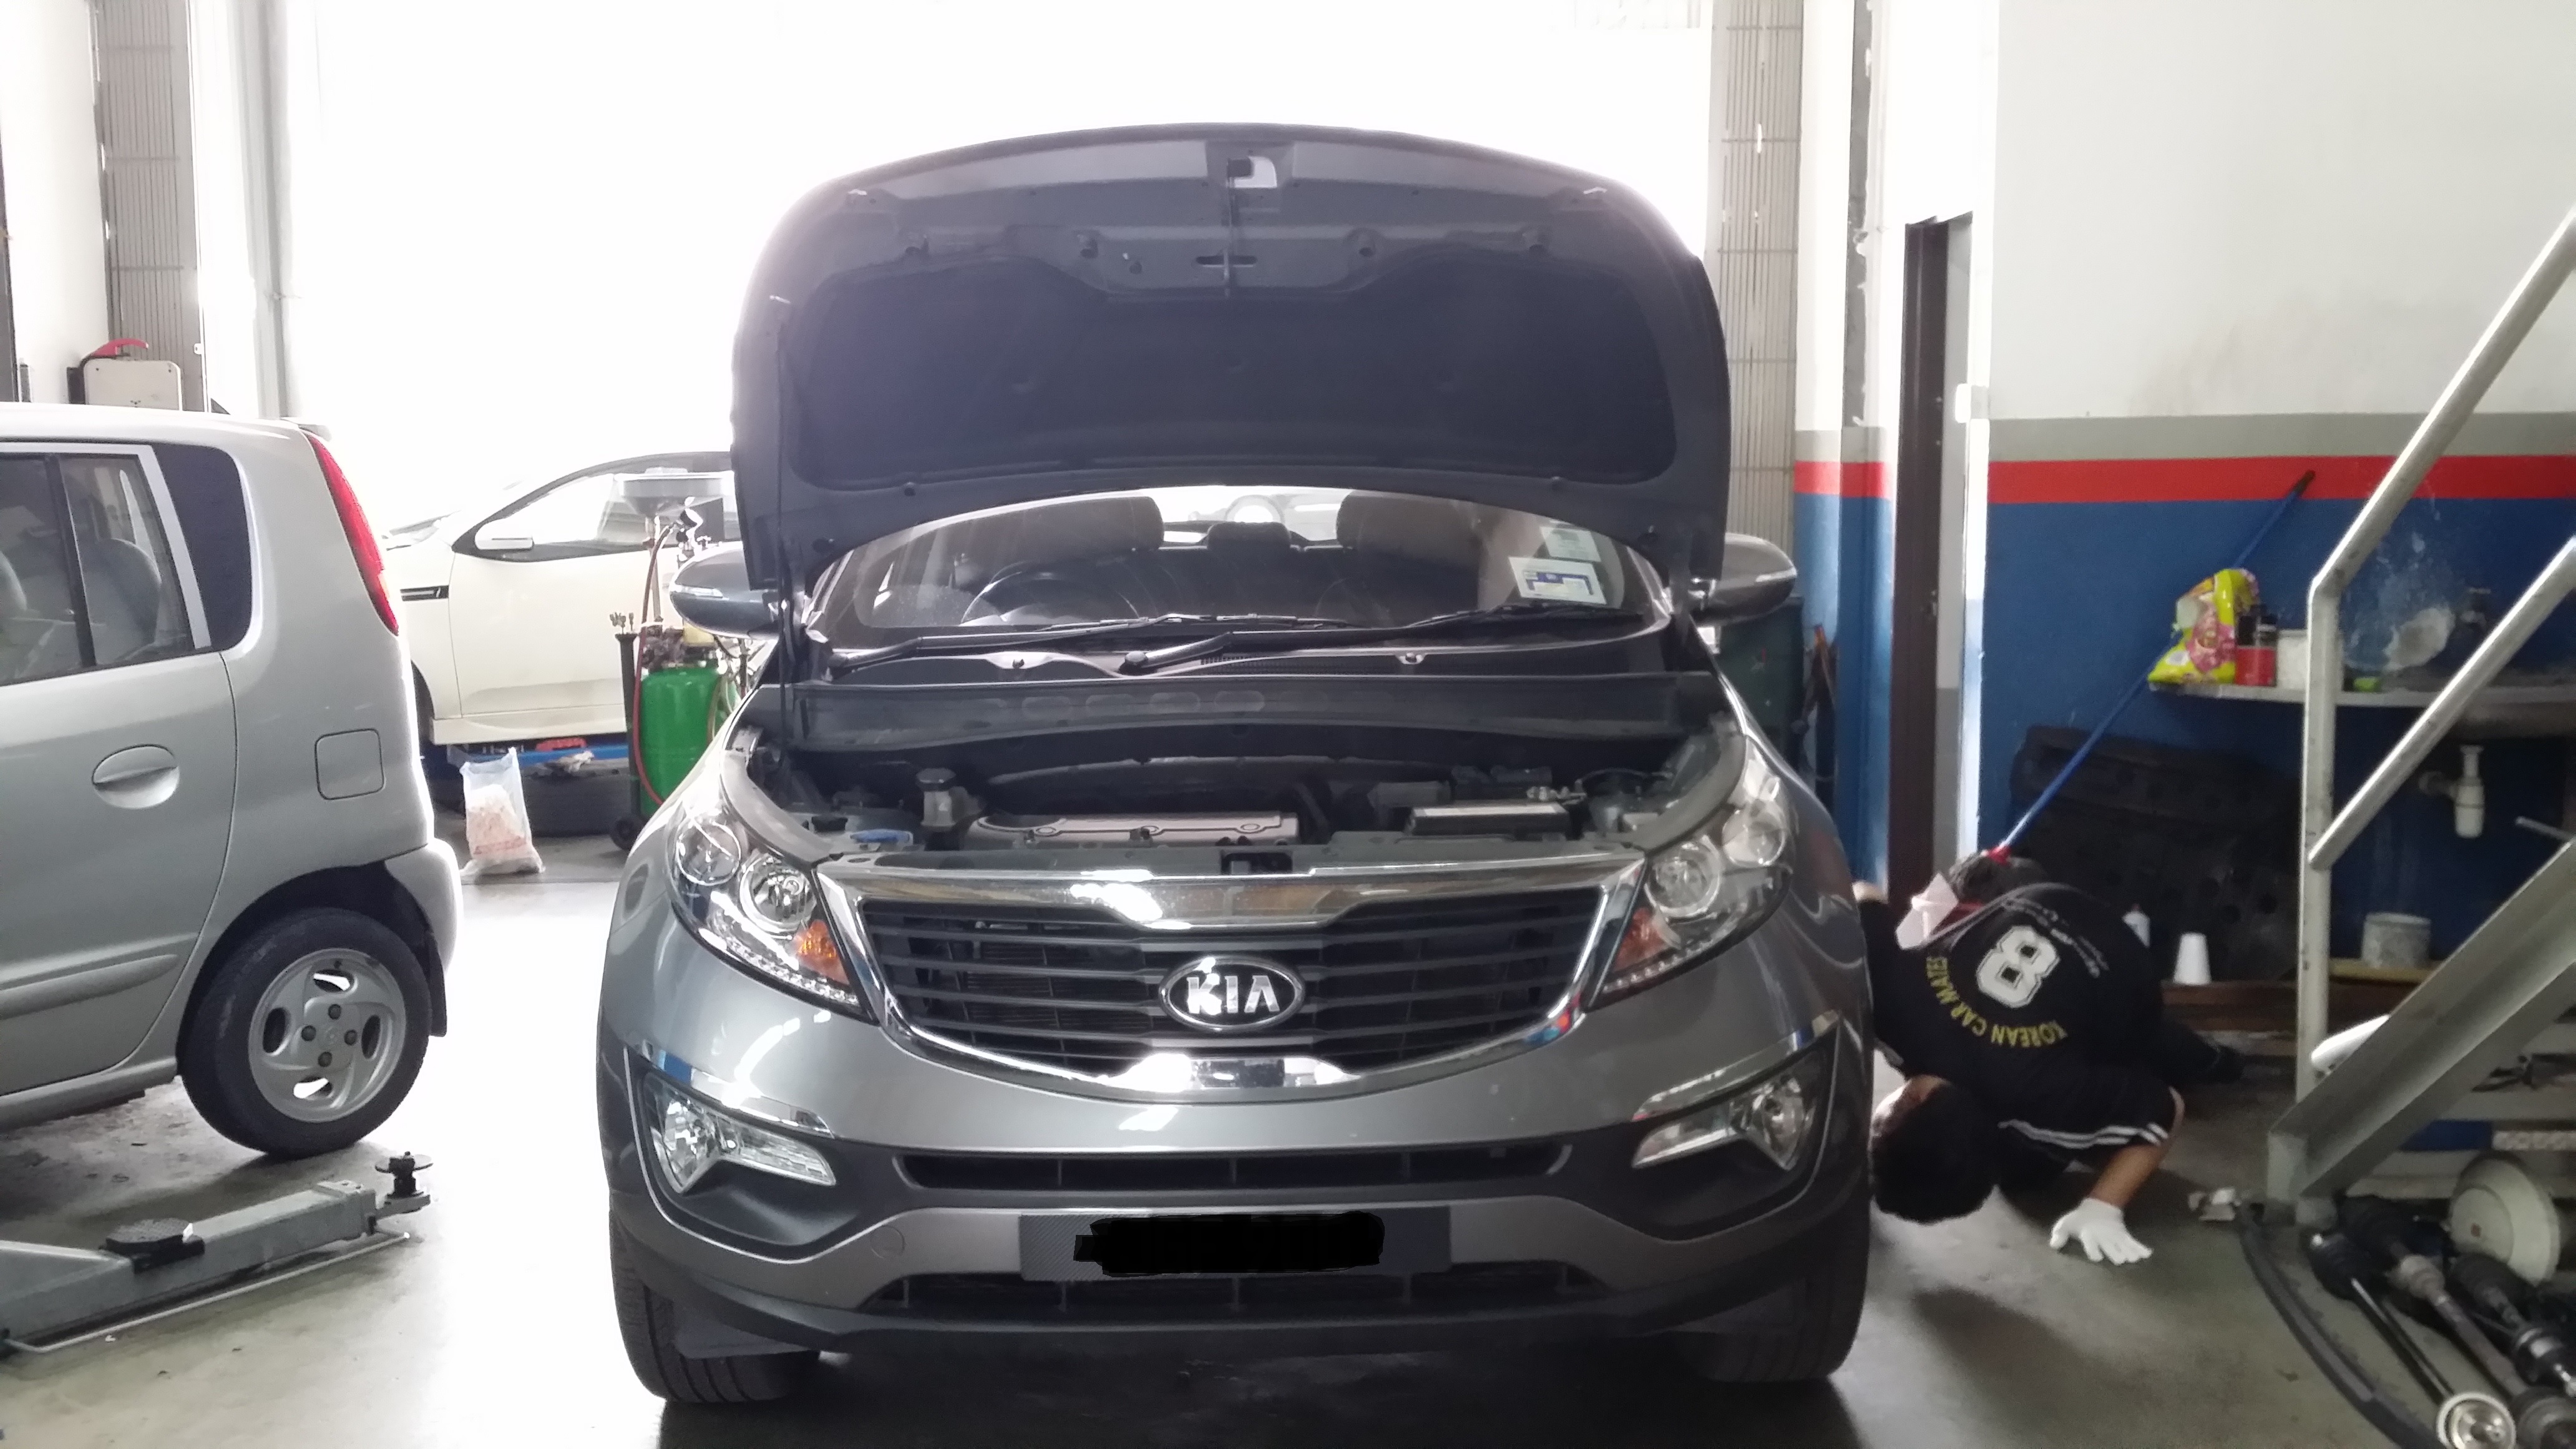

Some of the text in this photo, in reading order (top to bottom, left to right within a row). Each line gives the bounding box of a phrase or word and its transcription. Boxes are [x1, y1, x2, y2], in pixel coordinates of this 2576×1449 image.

[1976, 925, 2060, 1008] 8
[1187, 973, 1280, 1015] KIA
[1951, 1002, 1987, 1037] CAR
